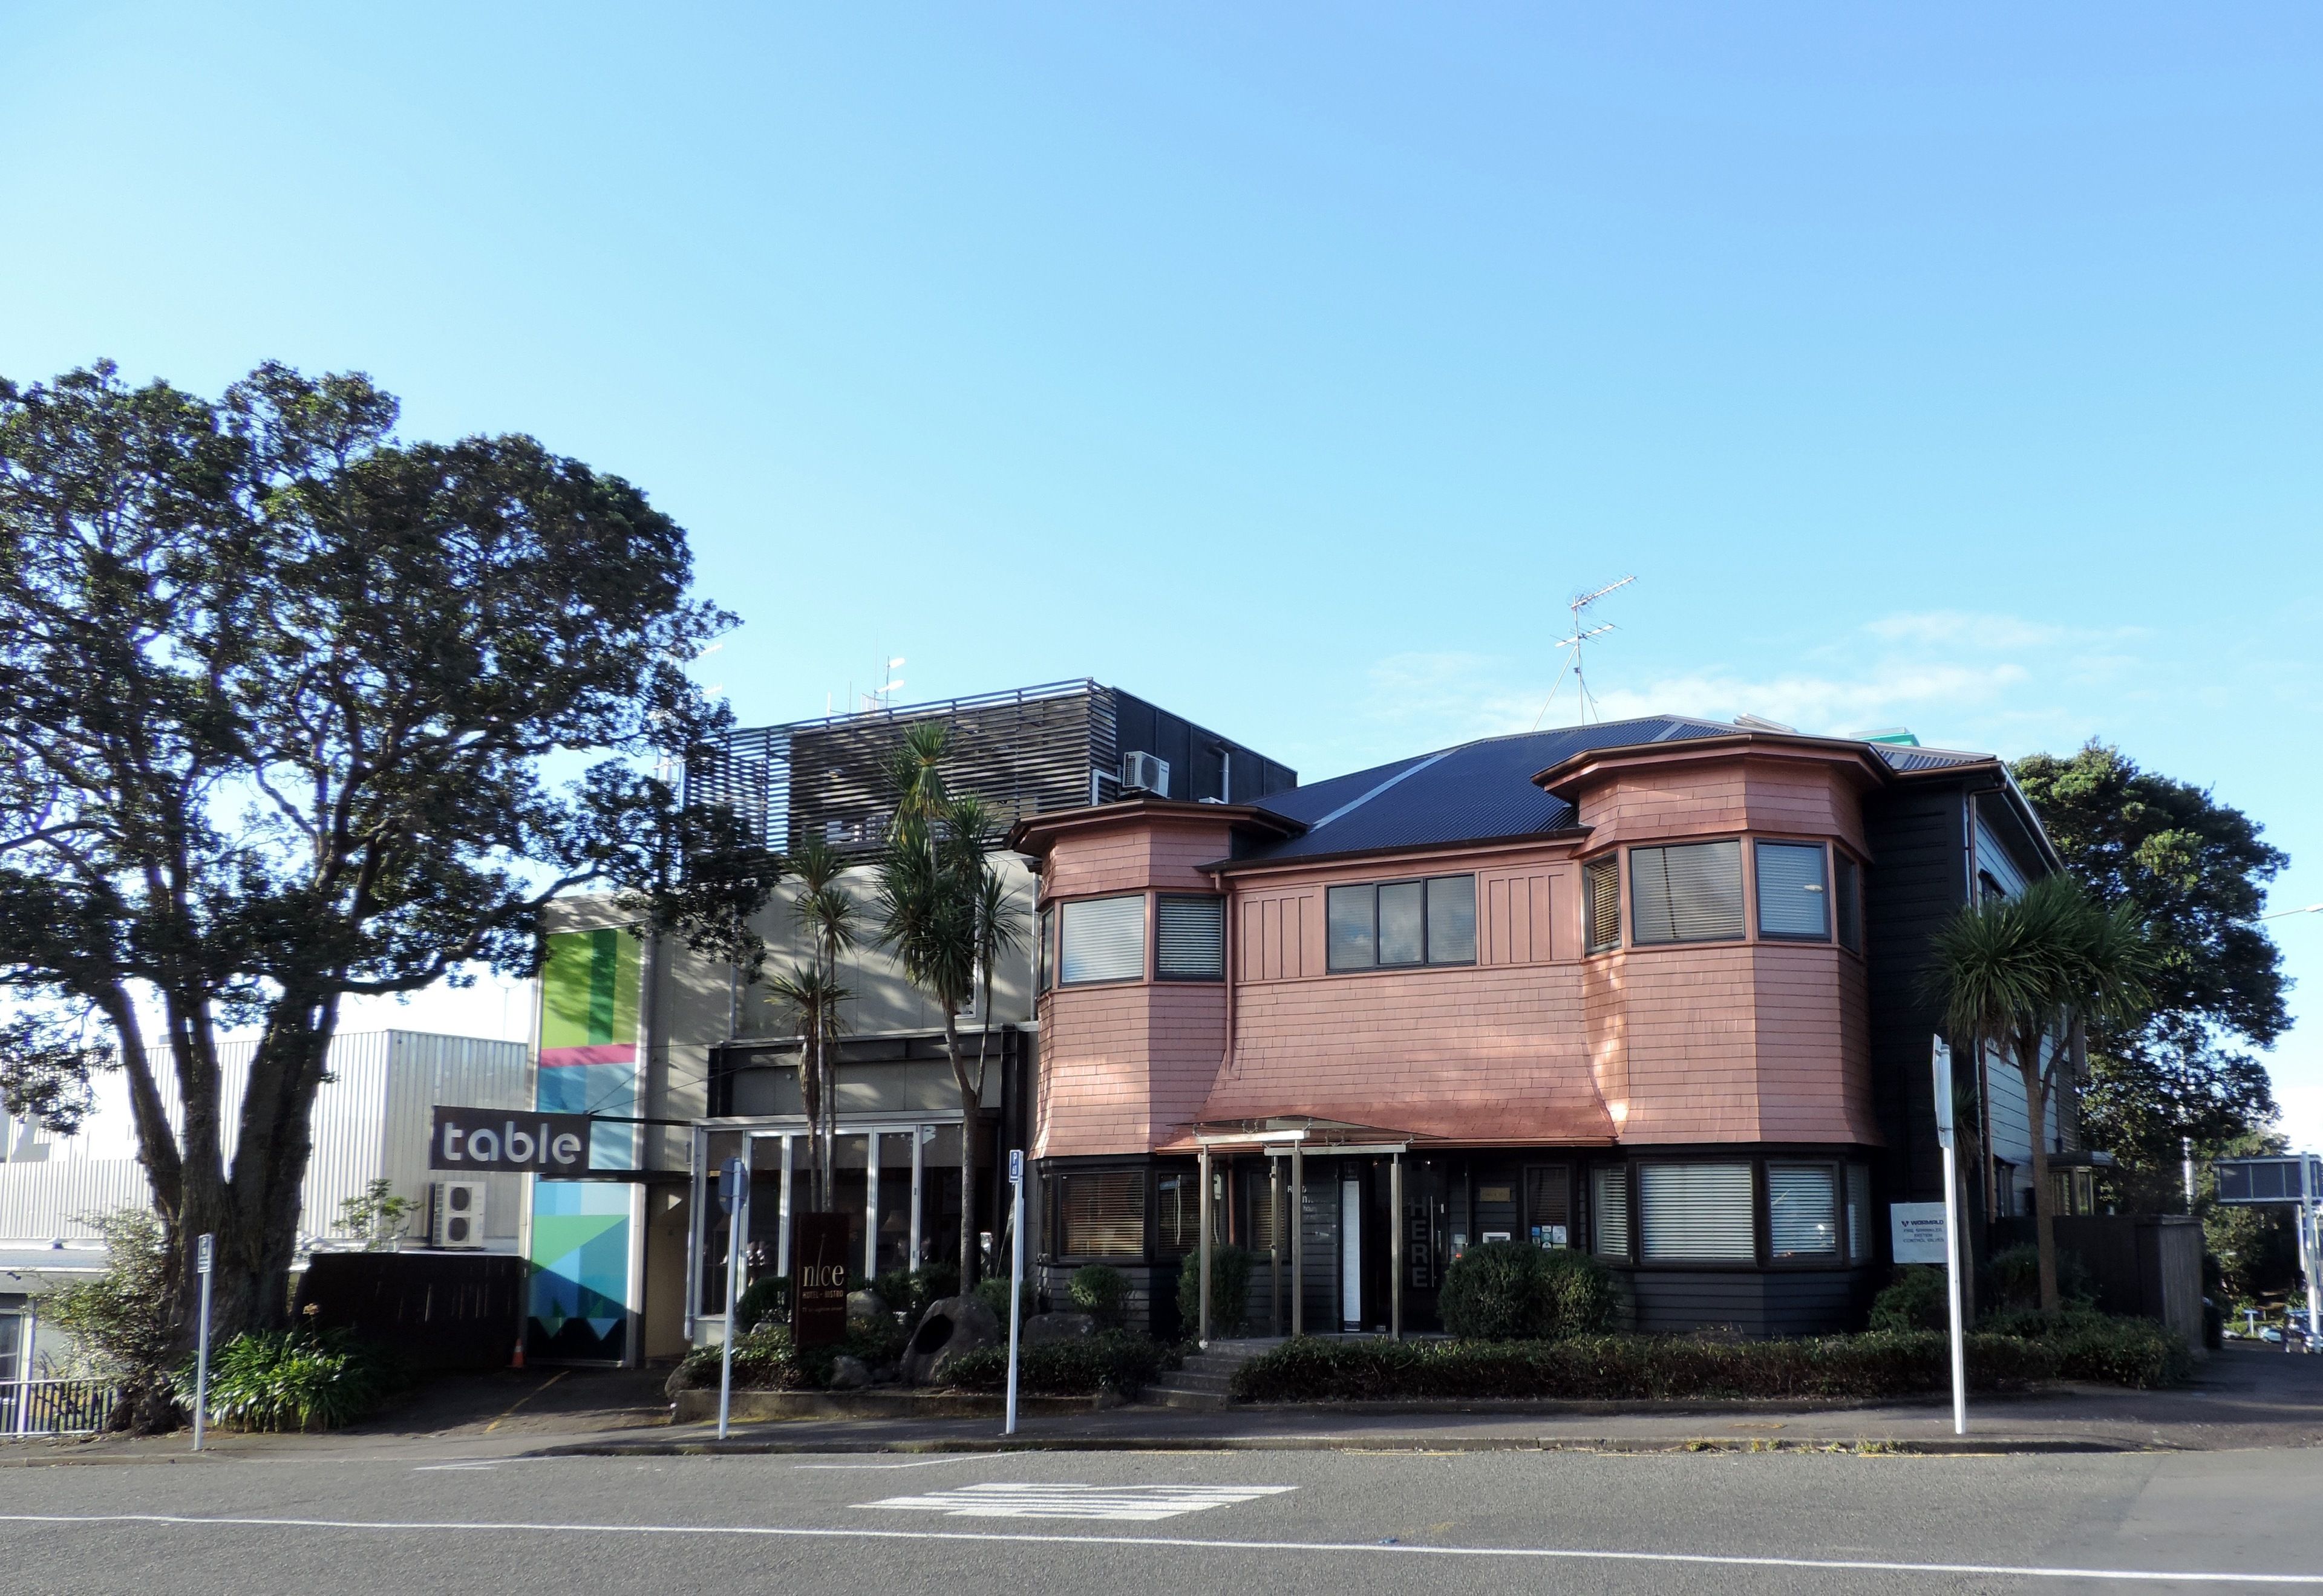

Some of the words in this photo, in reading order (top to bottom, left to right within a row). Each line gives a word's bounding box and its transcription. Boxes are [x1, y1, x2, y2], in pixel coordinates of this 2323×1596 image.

[443, 1121, 581, 1164] table
[1013, 1152, 1017, 1164] P
[1410, 1197, 1428, 1288] HERE
